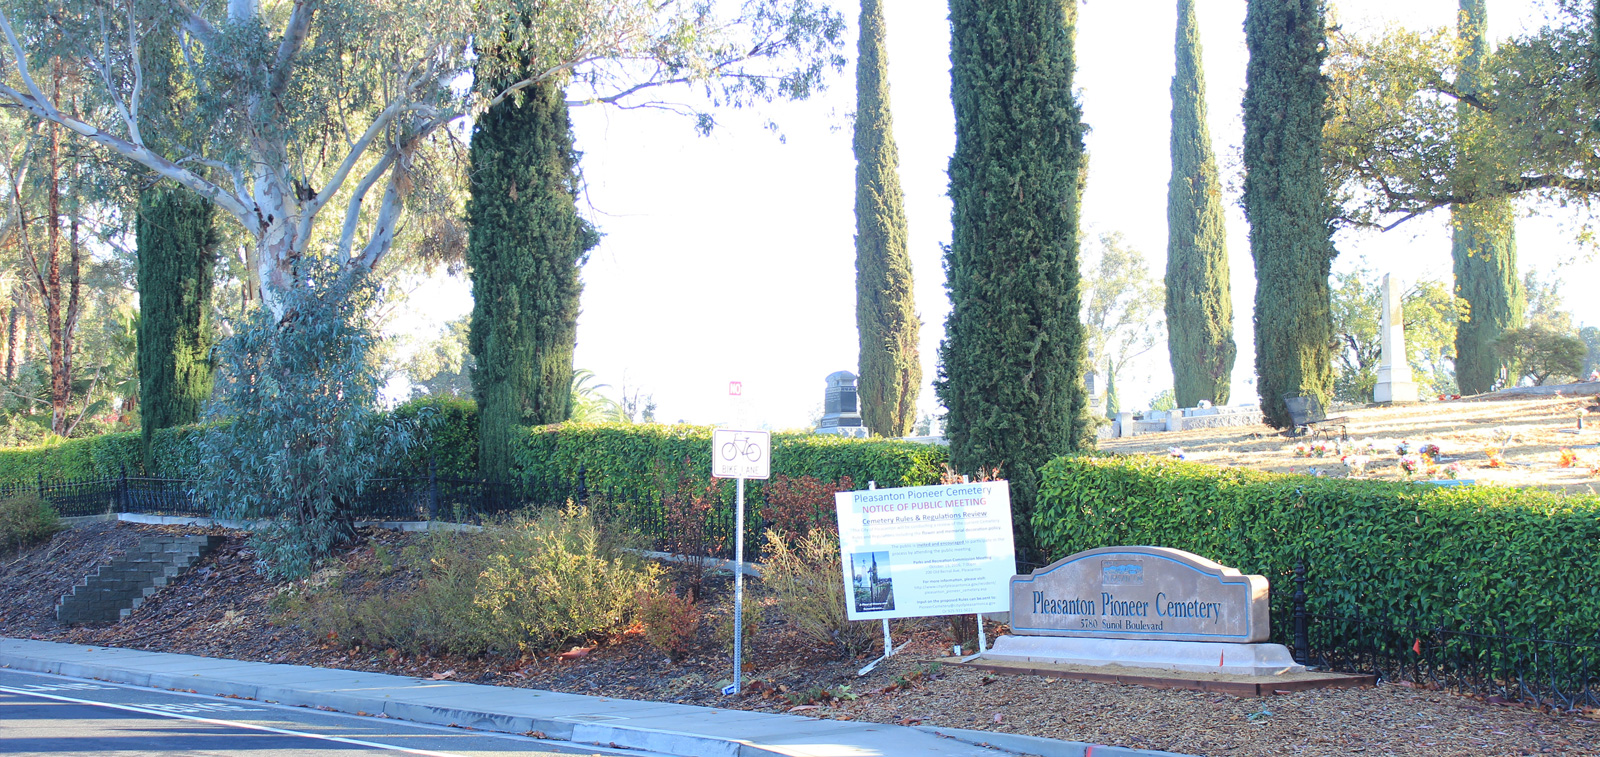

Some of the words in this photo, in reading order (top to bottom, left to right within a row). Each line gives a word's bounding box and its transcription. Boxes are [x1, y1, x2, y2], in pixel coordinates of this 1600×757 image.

[730, 383, 741, 394] NO
[722, 465, 737, 474] BIKE
[741, 466, 759, 475] LANE
[854, 493, 905, 503] Pleasanton
[908, 490, 943, 499] Pioneer
[946, 487, 992, 497] Cemetery
[862, 504, 895, 513] NOTICE
[897, 503, 909, 511] OF
[911, 500, 943, 510] PUBLIC
[945, 497, 987, 508] MEETING
[896, 515, 914, 523] Rules
[922, 512, 962, 521] Regulations
[1032, 590, 1096, 616] Pleasanton
[1101, 591, 1149, 617] Pioneer
[1155, 591, 1221, 625] Cemetery
[1080, 618, 1098, 629] 5780
[1101, 618, 1122, 630] Sunol
[1125, 619, 1163, 631] Boulevard
